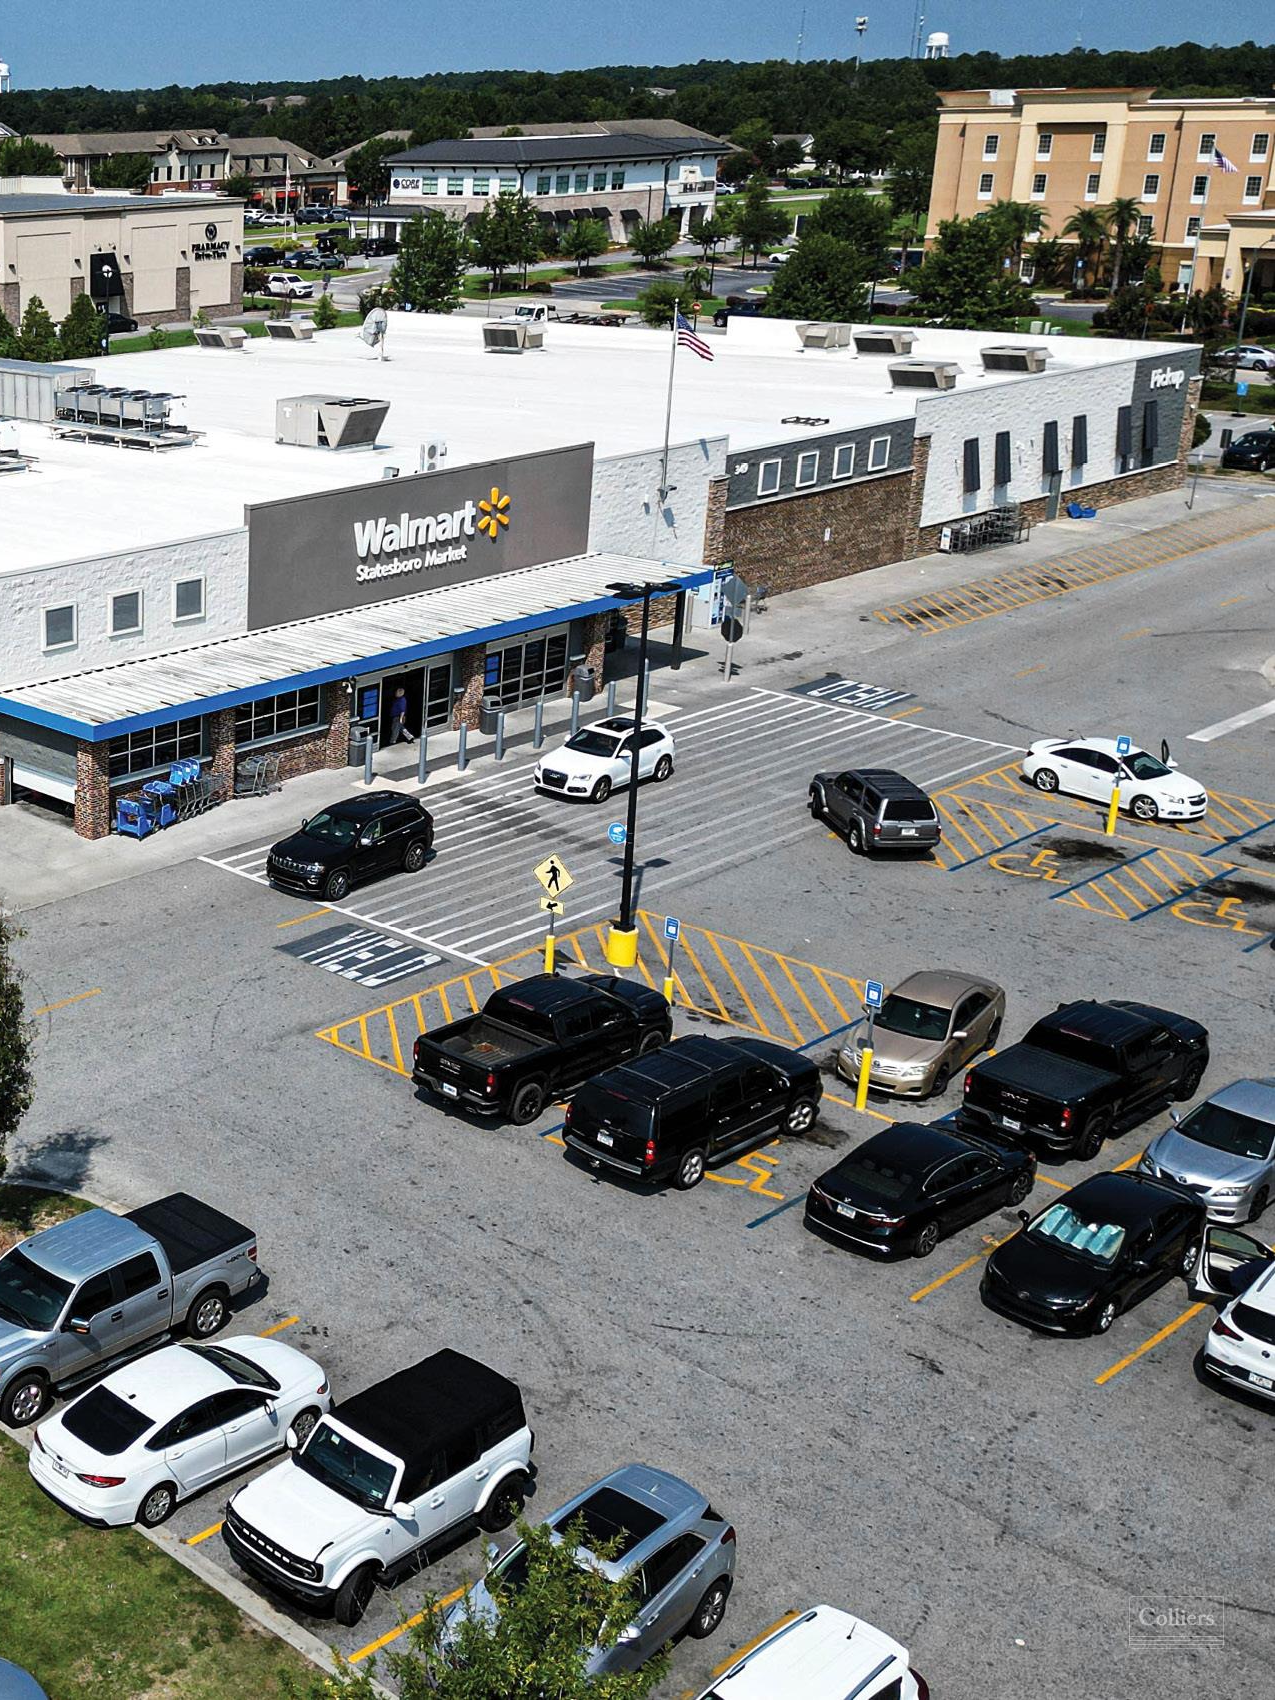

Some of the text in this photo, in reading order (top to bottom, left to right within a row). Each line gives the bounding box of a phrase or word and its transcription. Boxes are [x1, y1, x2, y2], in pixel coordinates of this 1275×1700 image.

[192, 241, 230, 253] PHARMACY
[1150, 367, 1185, 389] Pickup
[354, 500, 476, 557] Walmart
[356, 545, 467, 582] Statesboro Market
[297, 928, 442, 987] YIELD
